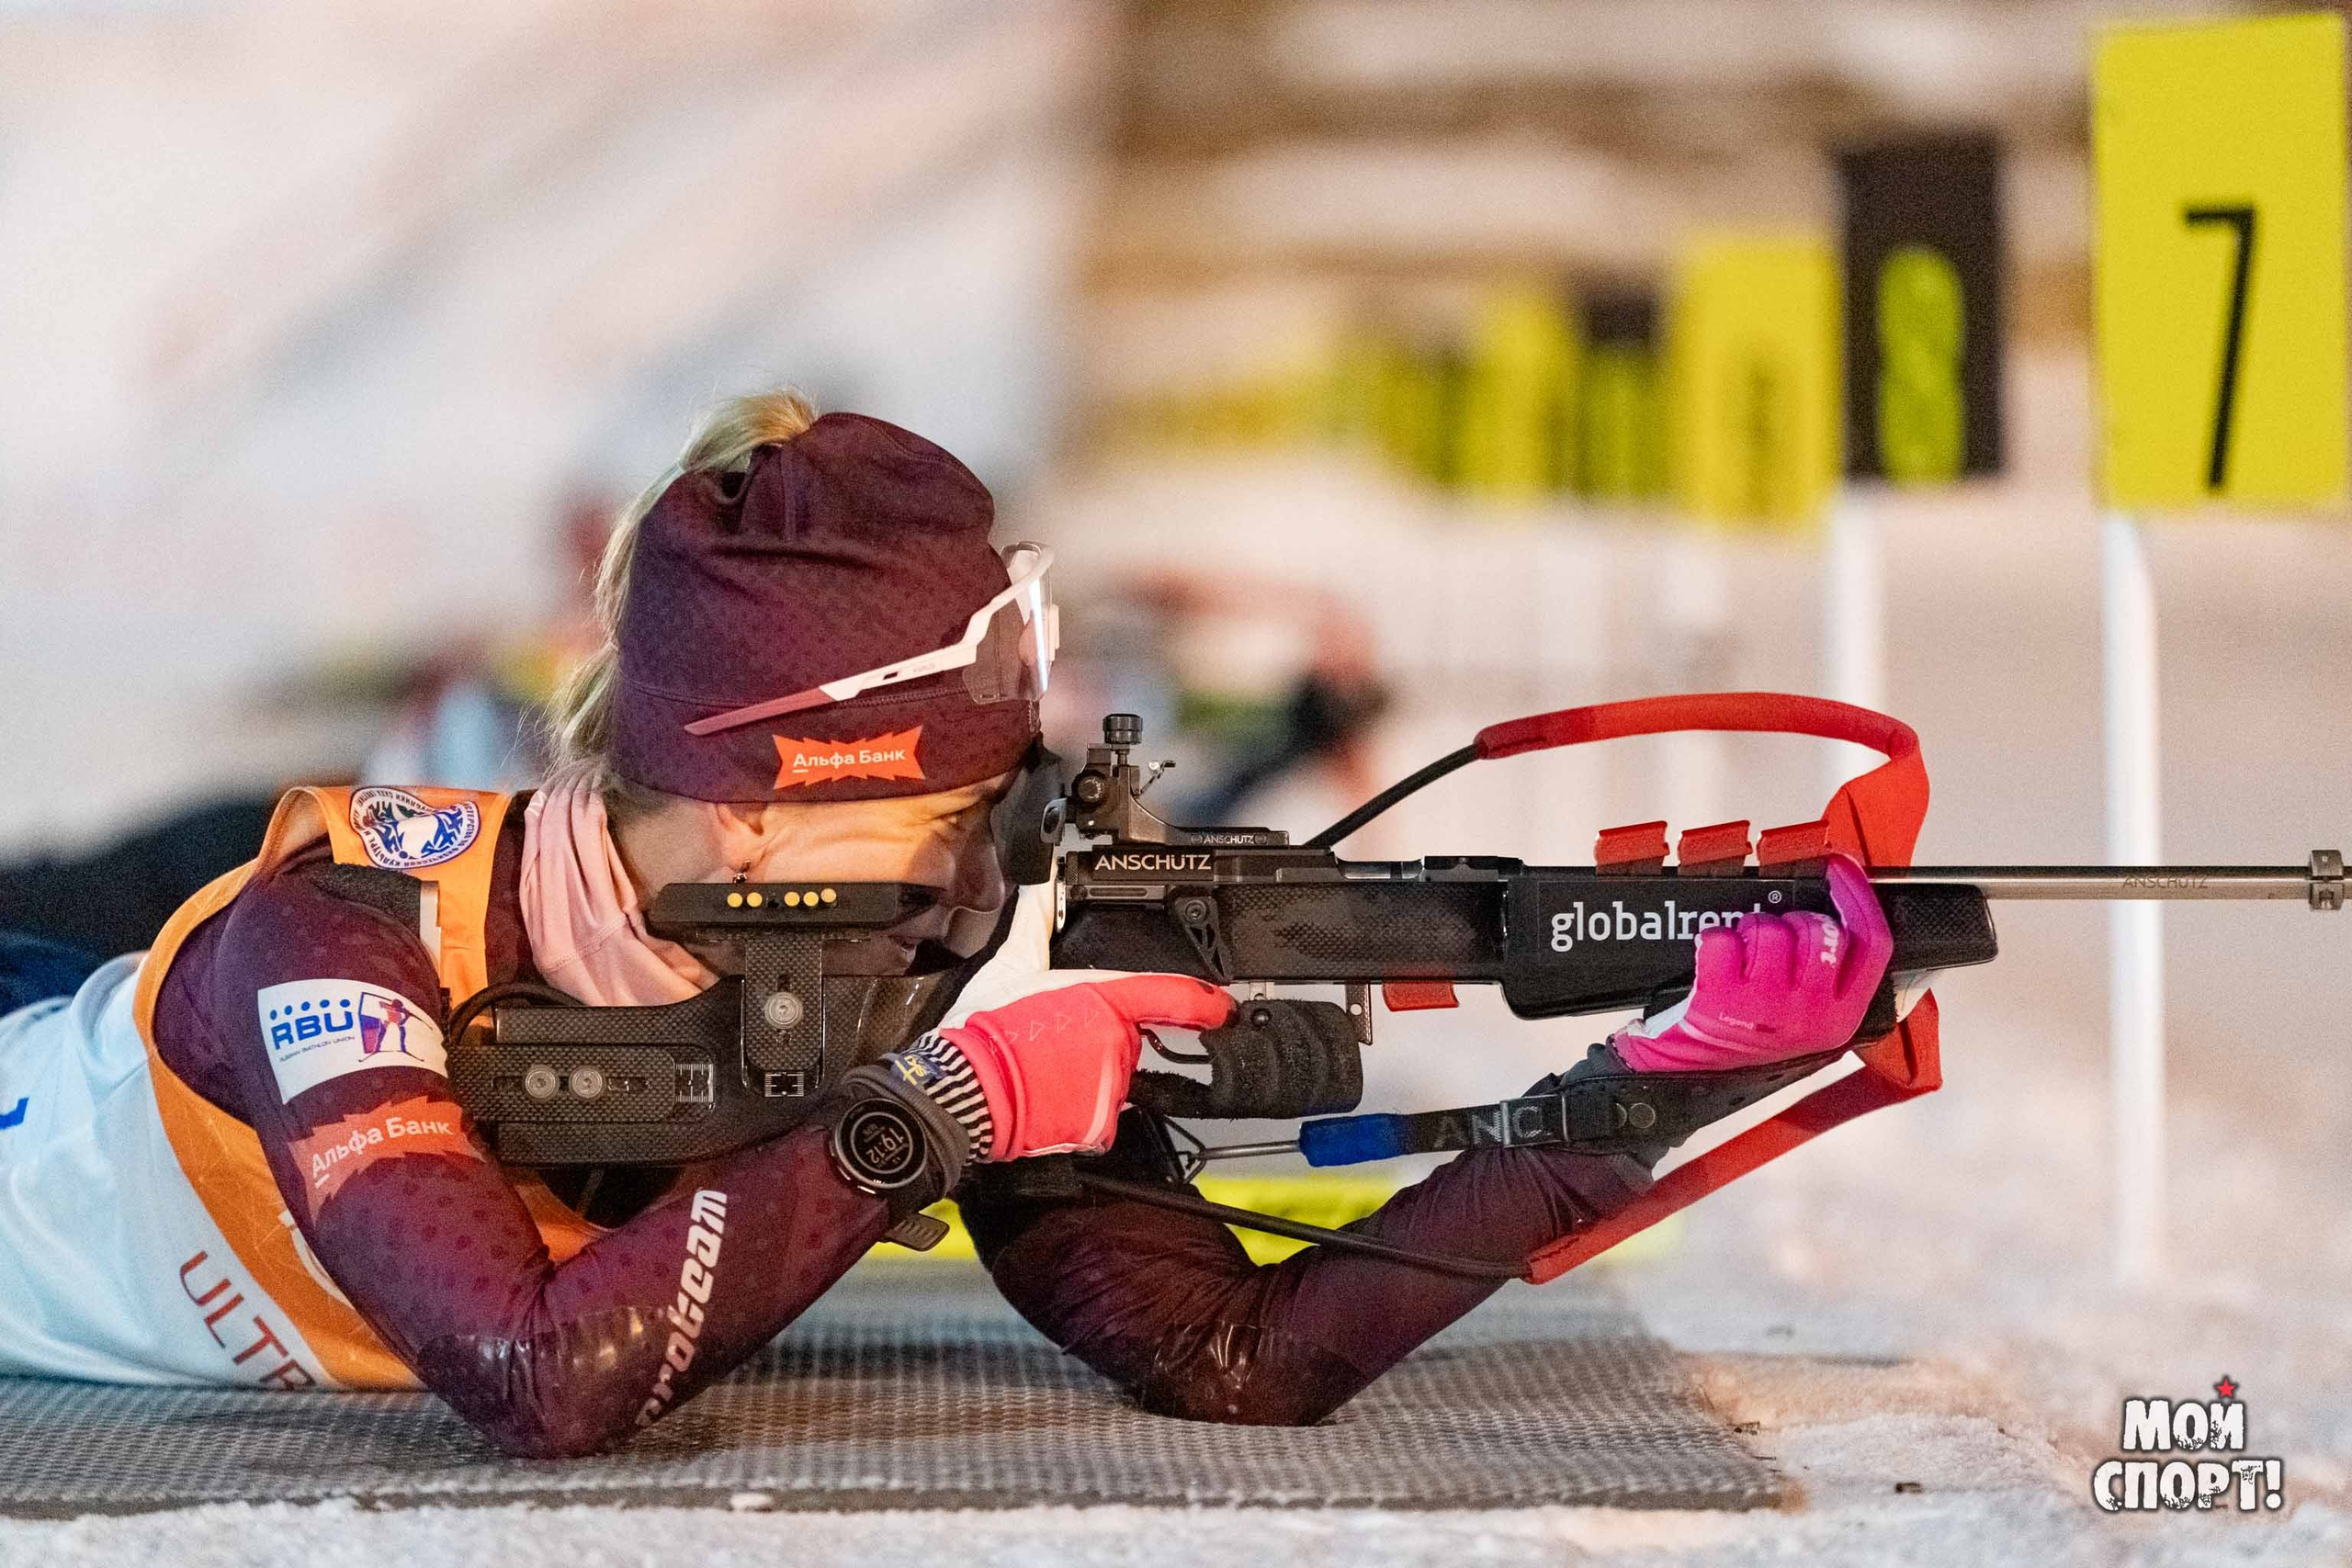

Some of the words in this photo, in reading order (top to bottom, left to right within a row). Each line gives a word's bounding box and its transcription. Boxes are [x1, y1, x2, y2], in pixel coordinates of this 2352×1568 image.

[2181, 198, 2257, 494] 7
[793, 751, 856, 771] Альфа
[859, 750, 906, 764] Банк
[1551, 900, 1762, 952] globalre
[270, 1010, 354, 1050] RBU
[311, 1127, 384, 1182] Альфа
[385, 1117, 454, 1139] Банк
